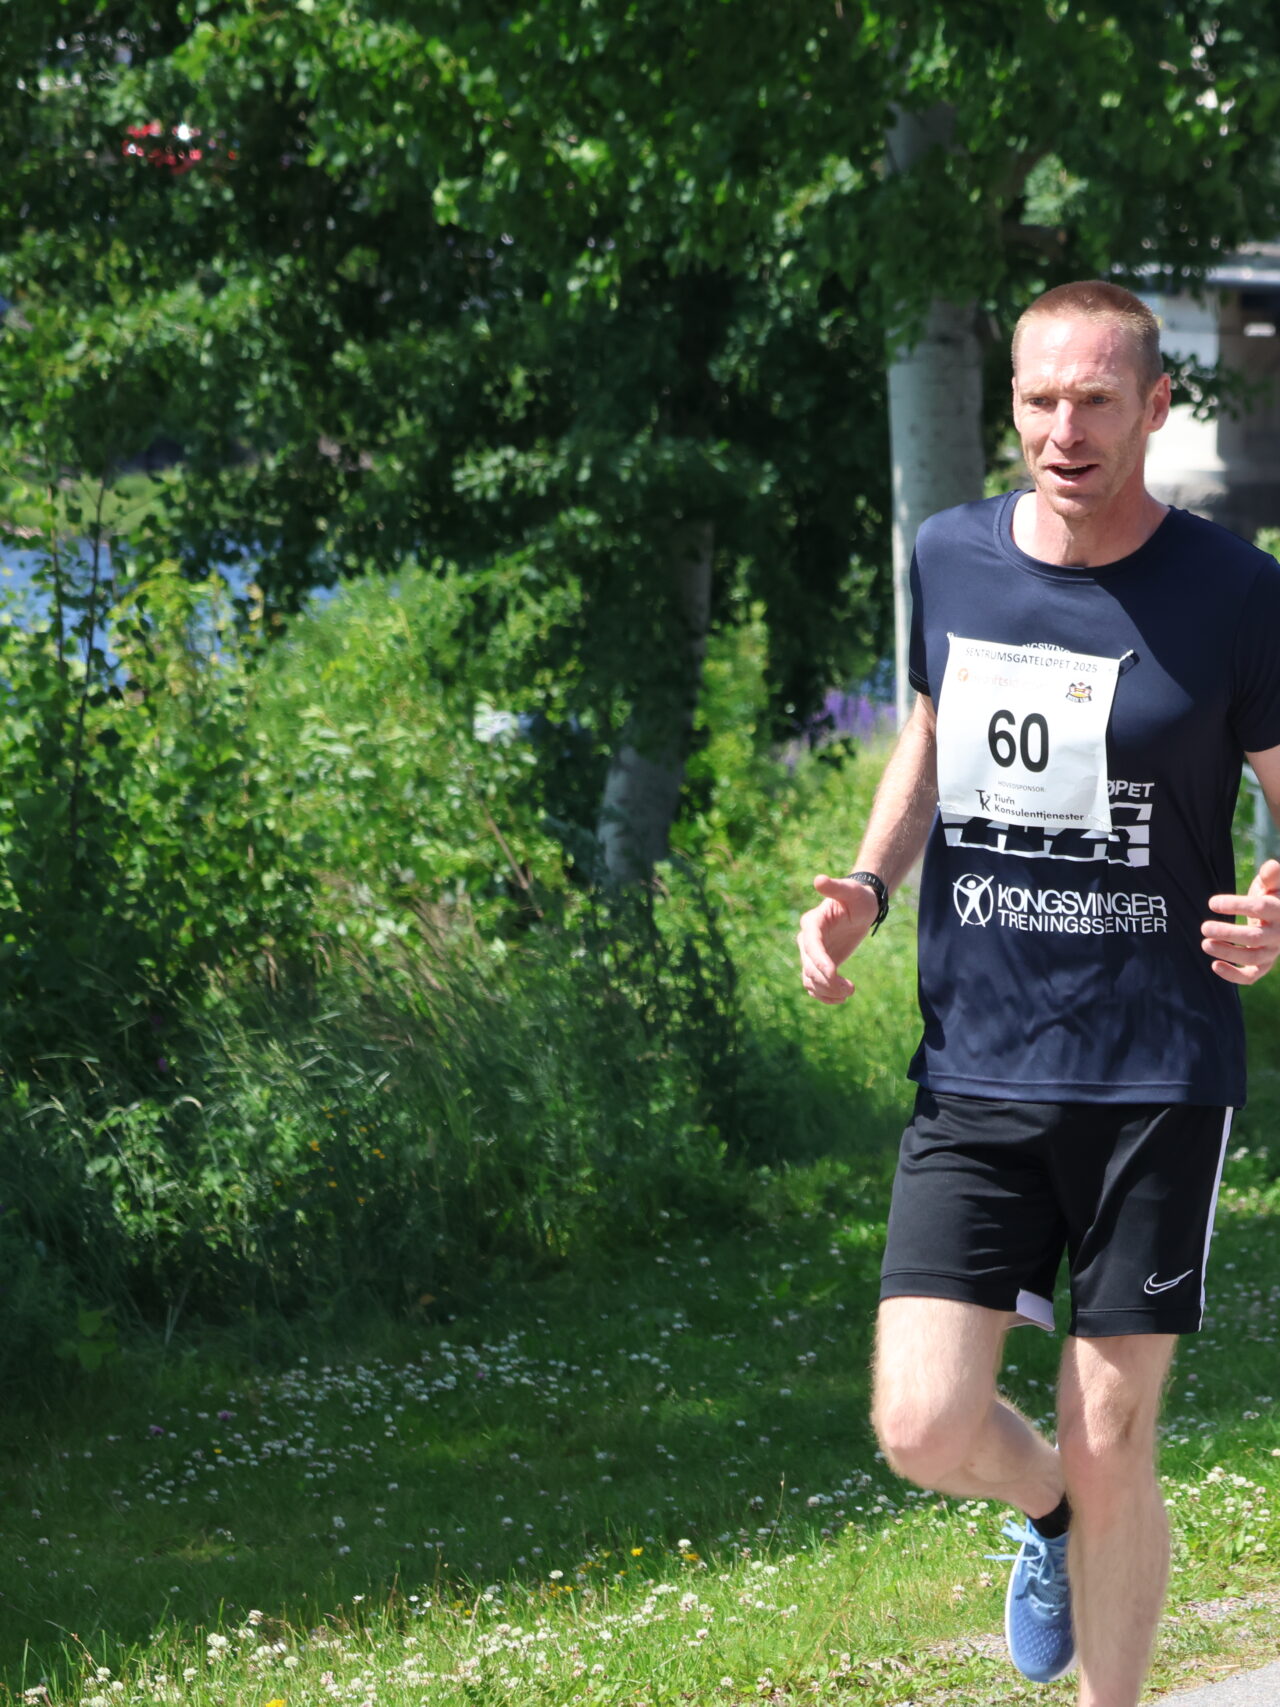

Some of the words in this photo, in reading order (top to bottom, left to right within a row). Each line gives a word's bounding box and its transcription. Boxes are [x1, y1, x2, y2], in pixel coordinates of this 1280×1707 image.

[965, 647, 1070, 669] SENTRUMSGATELØPET
[1072, 661, 1098, 673] 2025
[988, 709, 1050, 773] 60
[994, 805, 1084, 821] Konsulenttjenester
[997, 883, 1168, 918] KONGSVINGER
[998, 909, 1167, 935] TRENINGSSENTER
